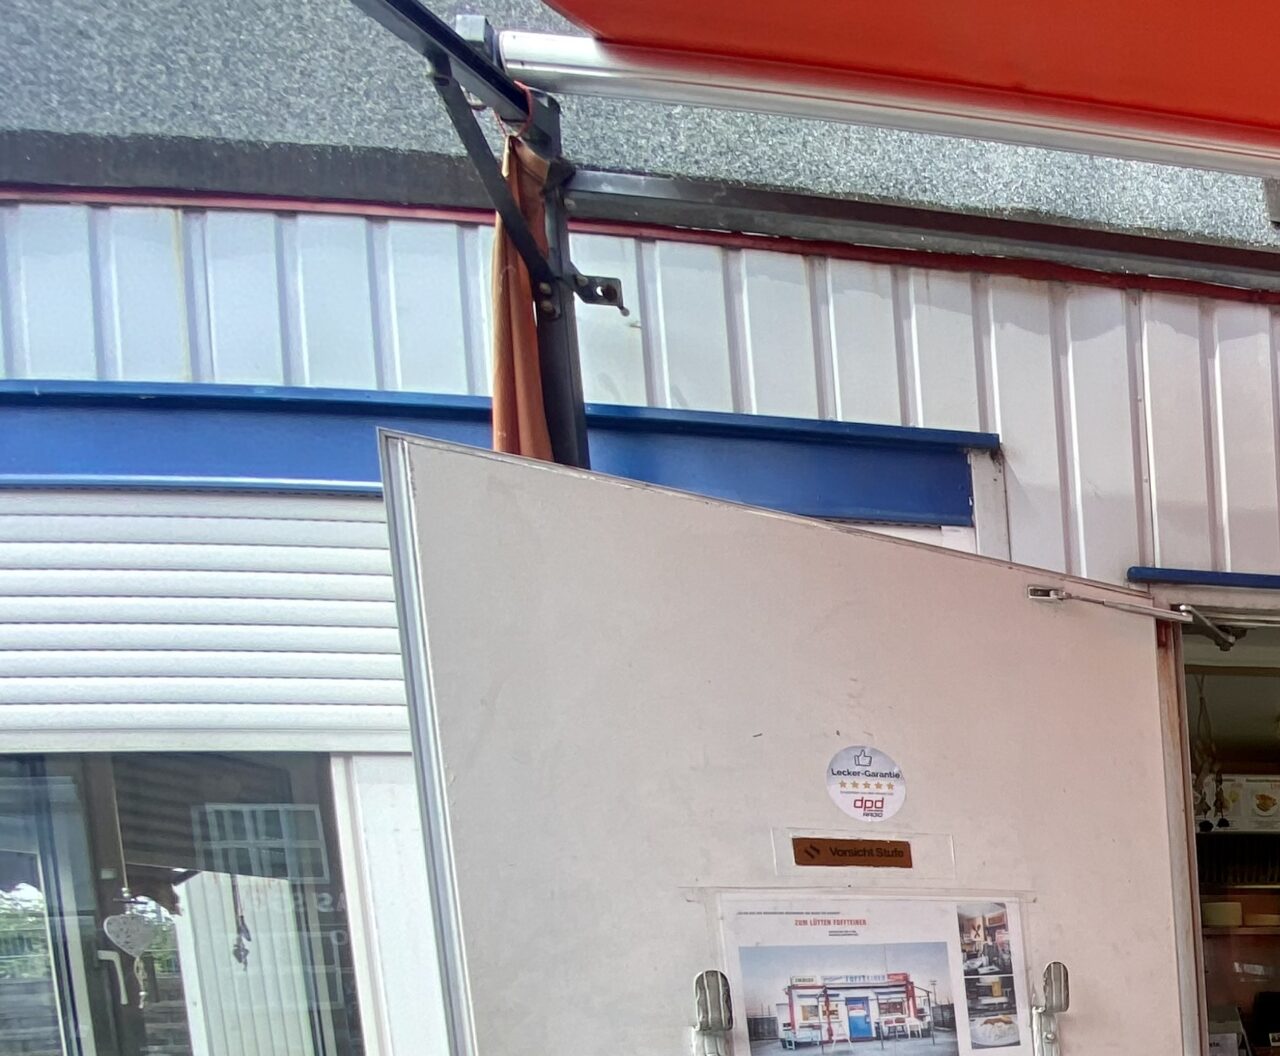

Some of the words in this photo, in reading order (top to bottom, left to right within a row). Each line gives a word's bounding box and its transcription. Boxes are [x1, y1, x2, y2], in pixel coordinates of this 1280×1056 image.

[831, 768, 900, 779] Lecker-Garantie
[853, 796, 884, 811] dpd
[829, 847, 874, 857] Vorsicht
[876, 848, 904, 858] Stufe
[810, 918, 831, 926] LÜTTEN
